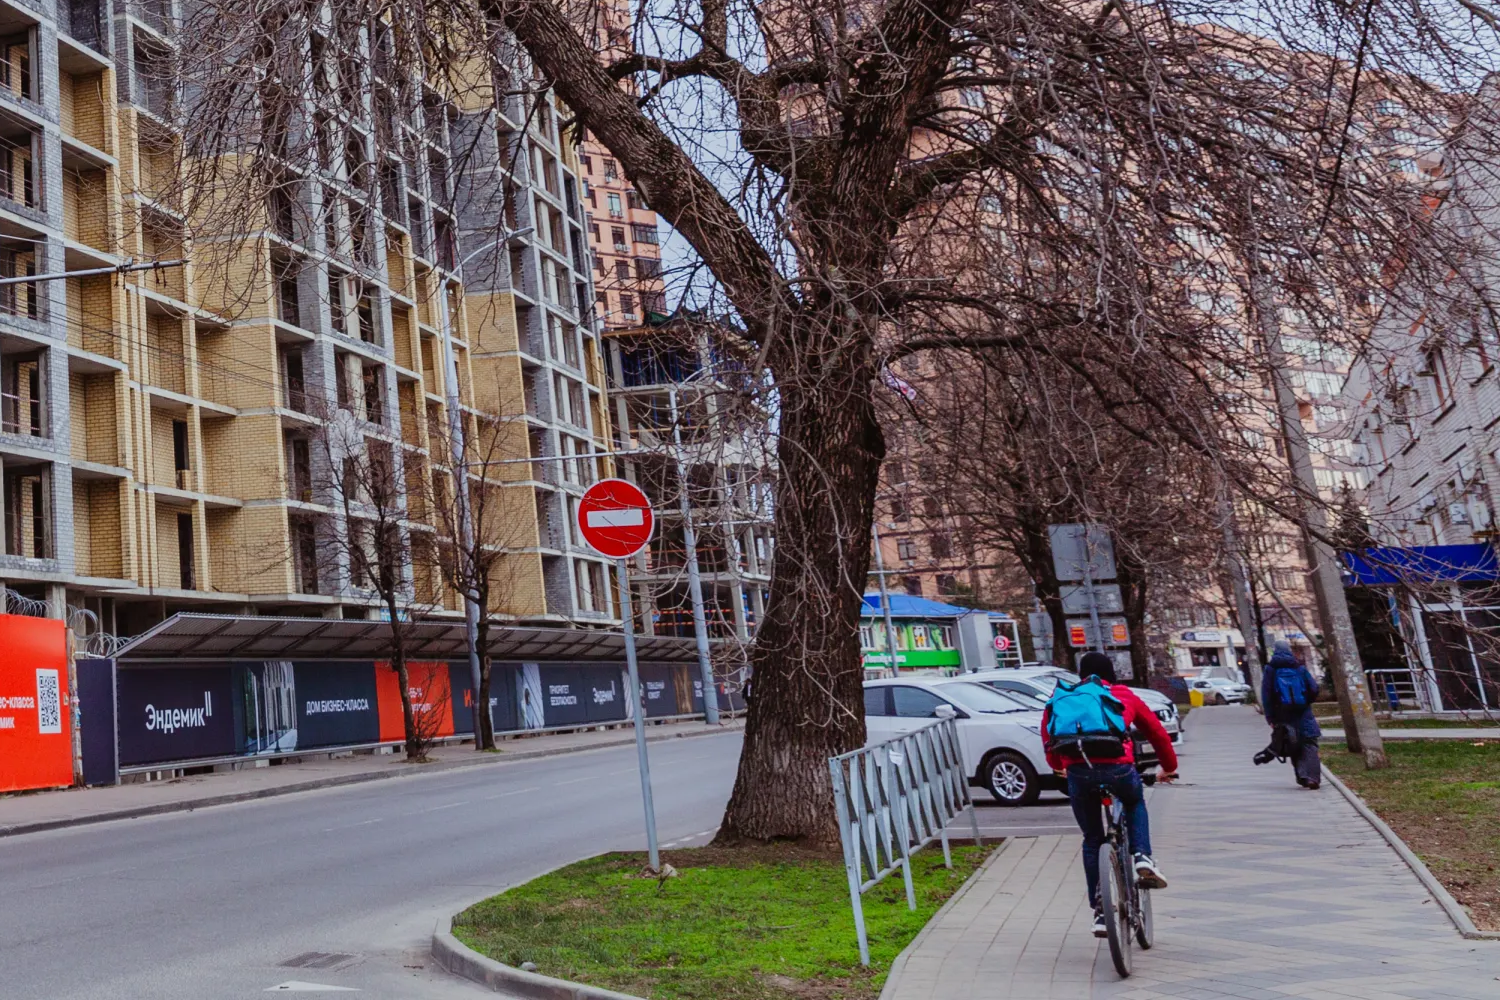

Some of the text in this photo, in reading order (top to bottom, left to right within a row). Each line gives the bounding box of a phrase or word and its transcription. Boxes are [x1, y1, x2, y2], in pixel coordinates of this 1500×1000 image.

[145, 703, 205, 734] Эндемик
[306, 697, 369, 716] ДОМ БИЗНЕС-КЛАССА
